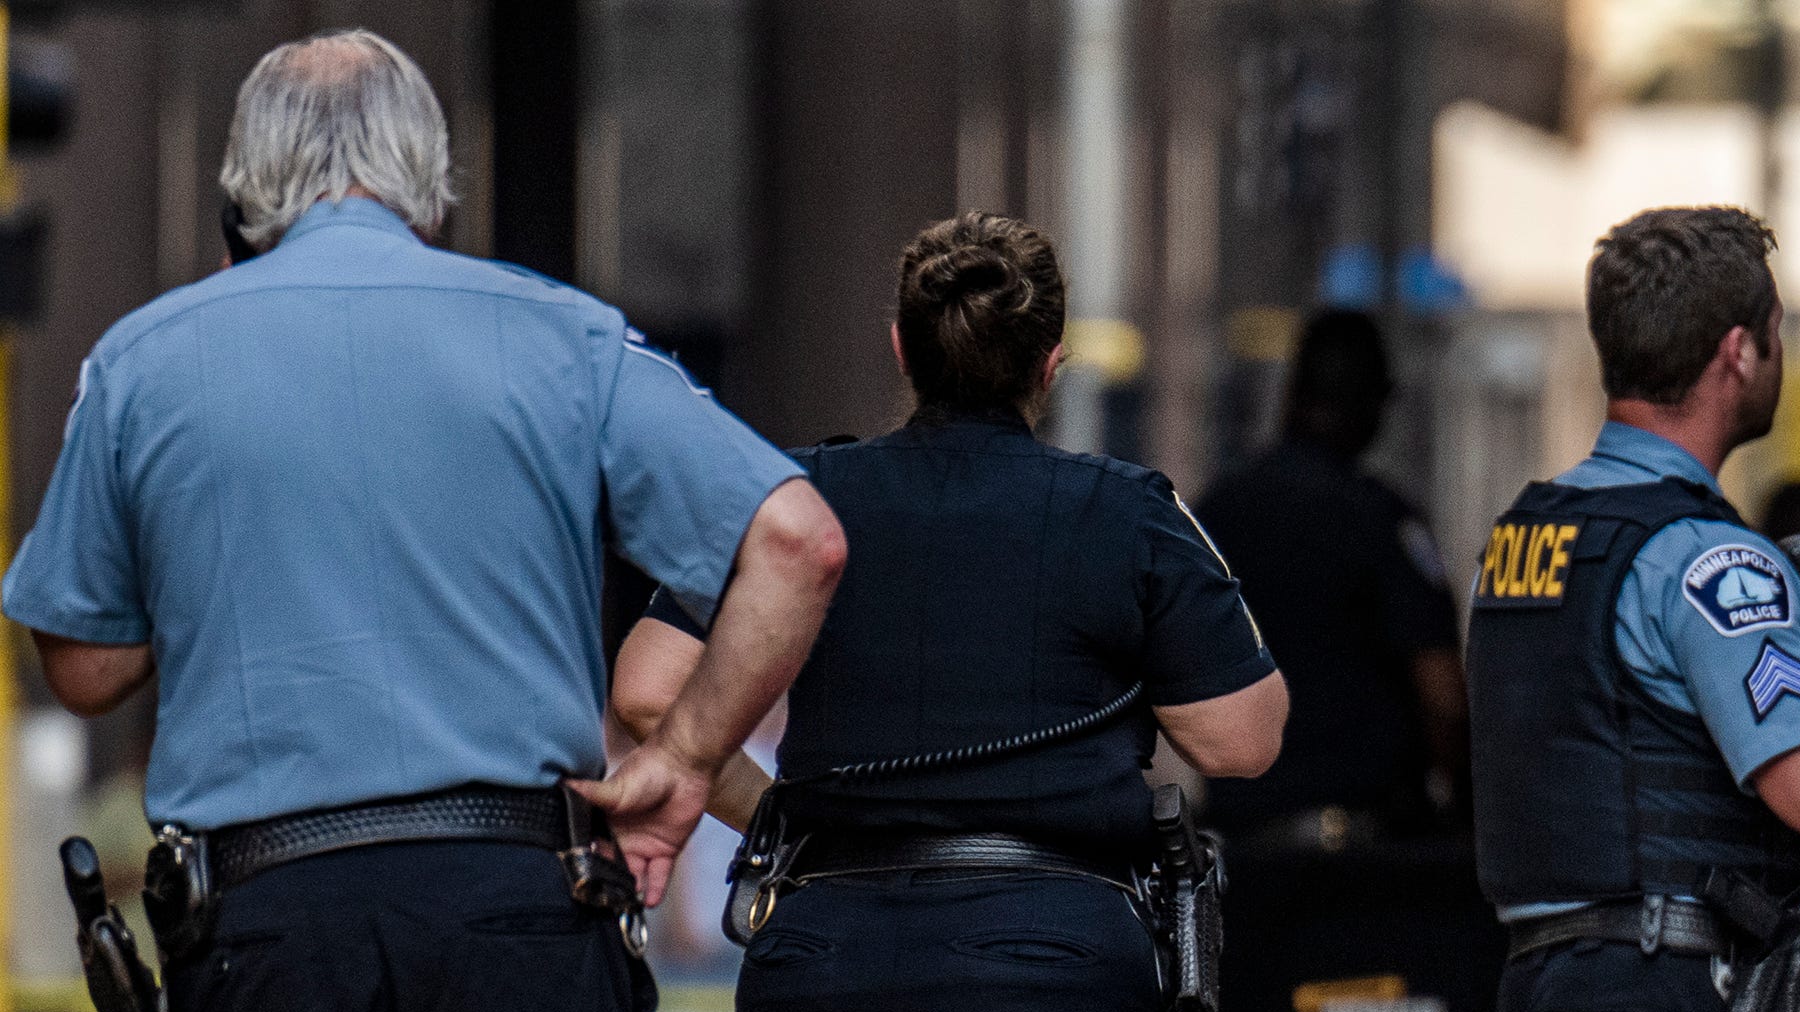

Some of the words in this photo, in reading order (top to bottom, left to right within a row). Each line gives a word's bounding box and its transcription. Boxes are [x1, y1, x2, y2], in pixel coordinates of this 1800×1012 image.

[1478, 523, 1578, 598] POLICE
[1687, 550, 1781, 590] MINNEAPOLIS
[1729, 604, 1782, 628] POLICE
